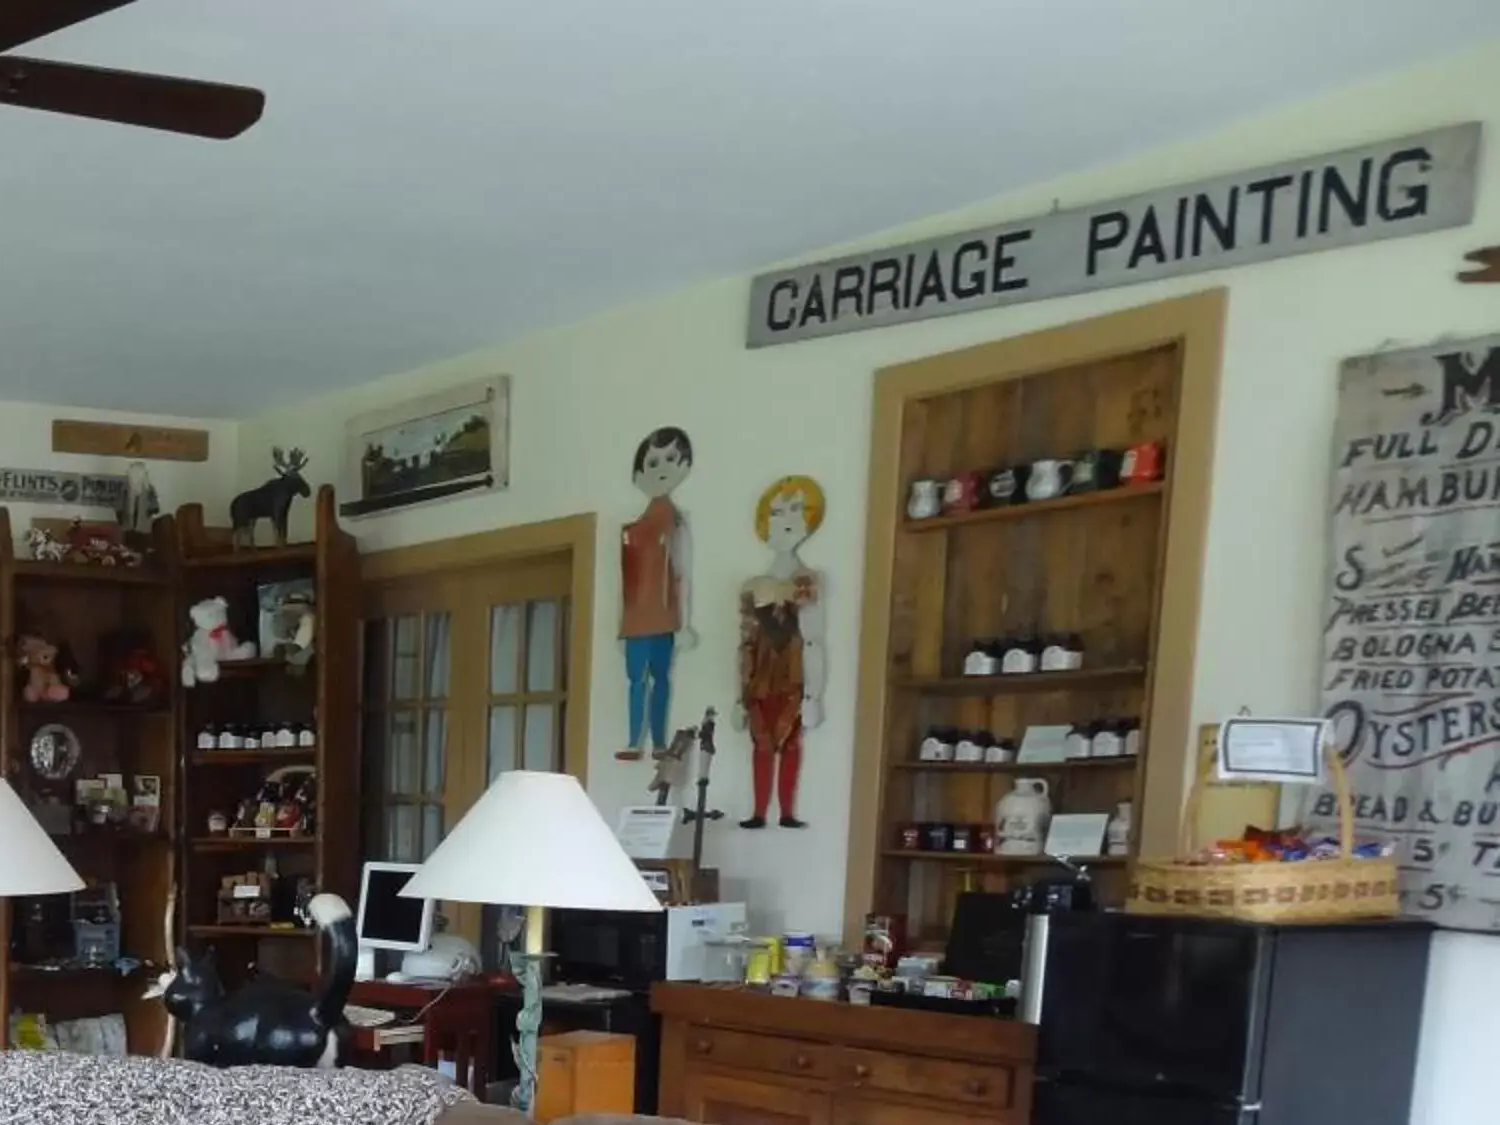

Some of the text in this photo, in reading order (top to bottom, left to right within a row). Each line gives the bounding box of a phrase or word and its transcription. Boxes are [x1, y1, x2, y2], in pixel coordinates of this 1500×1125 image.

[767, 147, 1433, 333] CARRIAGE PAINTING
[1338, 420, 1500, 468] FULL D
[1330, 631, 1477, 662] BOLOGNA
[1323, 667, 1415, 692] FRIED
[1312, 793, 1408, 824] BEAD
